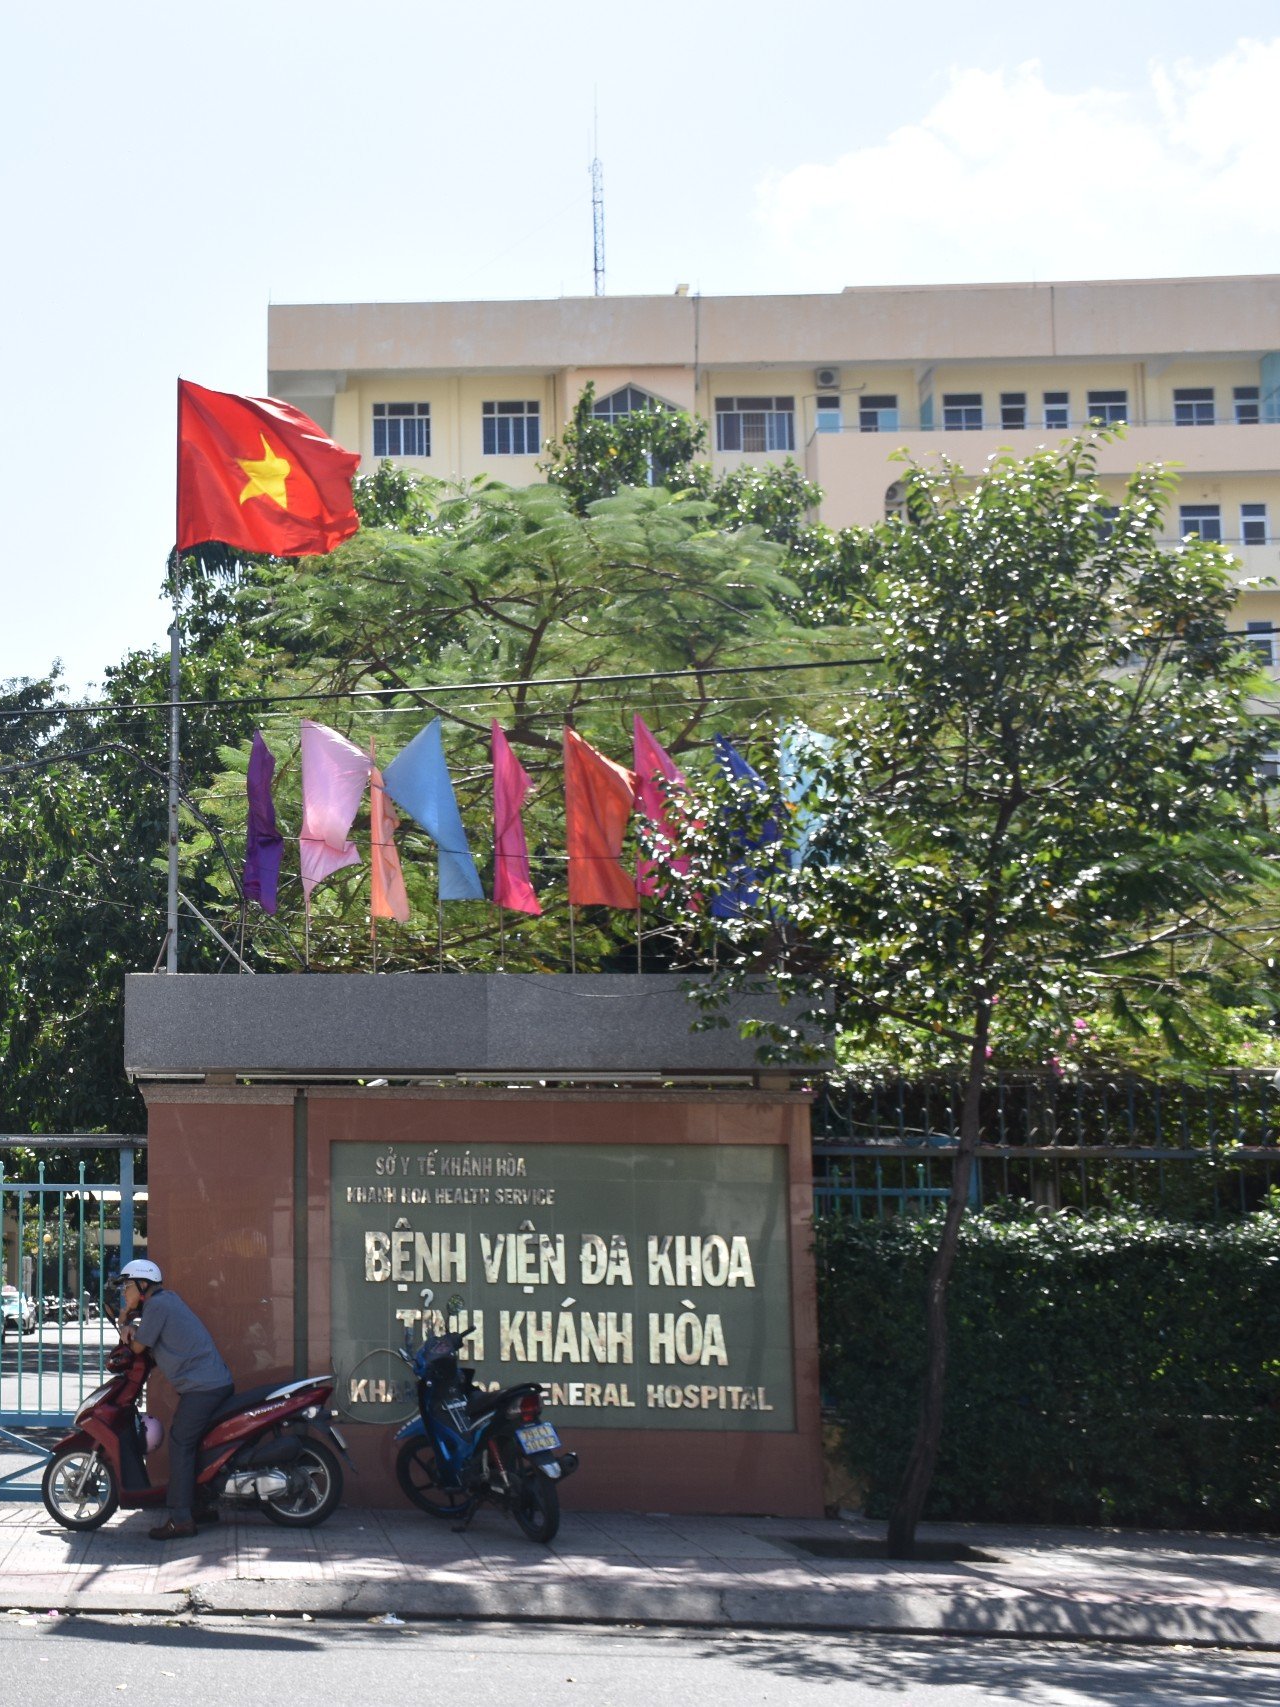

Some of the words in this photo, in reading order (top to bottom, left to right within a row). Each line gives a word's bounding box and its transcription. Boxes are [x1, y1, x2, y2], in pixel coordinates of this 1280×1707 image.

[375, 1146, 397, 1176] SỞ
[401, 1157, 410, 1176] Y
[417, 1149, 439, 1176] TẾ
[441, 1150, 493, 1177] KHÁNH
[496, 1152, 528, 1177] HÒA
[346, 1186, 397, 1204] KHANH
[401, 1187, 431, 1204] HOA
[435, 1188, 490, 1205] HEALTH
[494, 1189, 556, 1206] SERVICE
[364, 1217, 467, 1292] BỆNH
[480, 1219, 566, 1294] VIỆN
[579, 1234, 634, 1287] ĐA
[647, 1234, 756, 1289] KHOA
[499, 1297, 634, 1365] KHÁNH
[649, 1299, 729, 1367] HÒA
[539, 1383, 636, 1408] ENERAL
[647, 1384, 774, 1411] HOSPITAL
